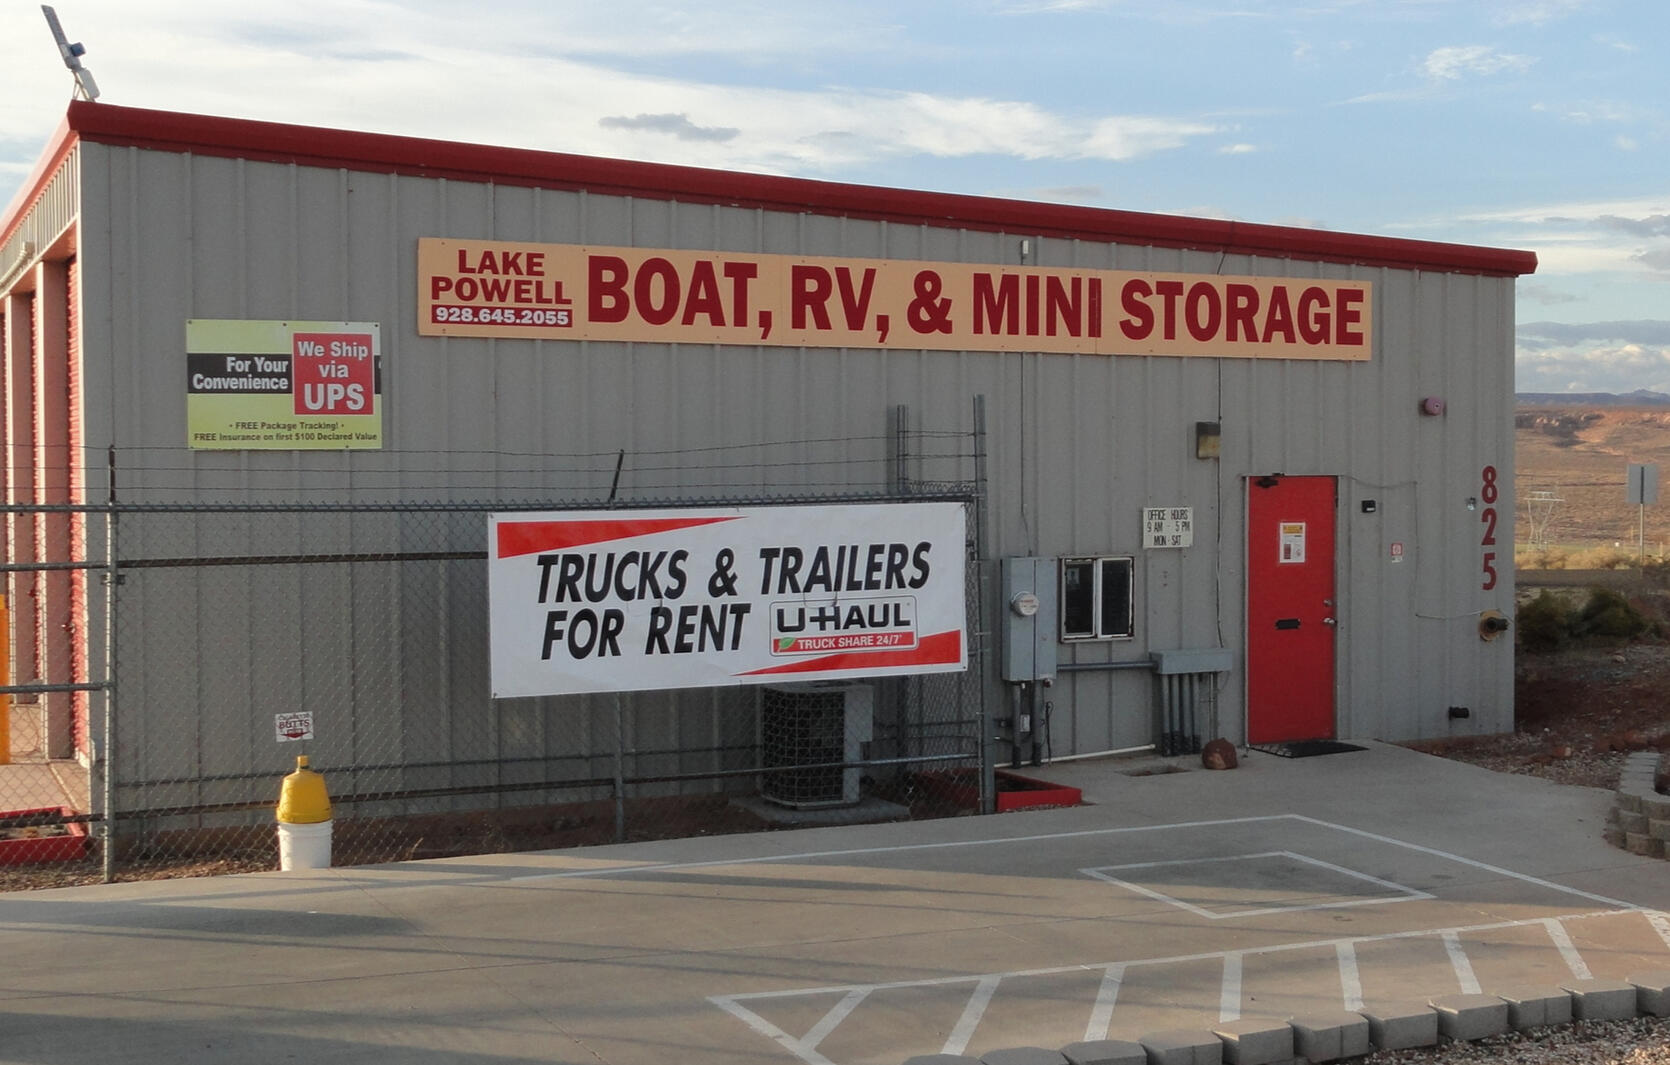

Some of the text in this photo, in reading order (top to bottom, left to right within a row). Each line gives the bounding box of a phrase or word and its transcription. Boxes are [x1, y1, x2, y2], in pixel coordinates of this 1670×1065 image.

[458, 249, 545, 276] LAKE
[431, 276, 572, 305] POWELL
[587, 256, 1364, 346] BOAT, RV, & MINI STORAGE
[436, 307, 569, 325] 928.645.2055
[298, 341, 369, 360] We Ship
[226, 357, 288, 373] For Your
[318, 360, 349, 378] via
[192, 374, 288, 390] Convenience
[304, 383, 365, 411] UPS
[236, 422, 339, 431] FREE Package Tracking!
[194, 433, 217, 441] FREE
[219, 433, 261, 441] Insurance
[276, 433, 293, 441] first
[295, 432, 315, 441] $100
[317, 432, 353, 441] Declared
[355, 432, 377, 441] Value
[1148, 509, 1189, 520] OFFICE HOURS
[1147, 521, 1152, 533] 9
[1154, 521, 1163, 533] AM
[1175, 521, 1180, 532] 5
[1181, 521, 1191, 532] PM
[1153, 535, 1182, 546] MON SAT
[537, 541, 933, 604] TRUCKS & TRAILERS
[541, 603, 751, 661] FOR RENT
[798, 638, 836, 650] TRUCK
[838, 636, 875, 648] SHARE
[279, 720, 310, 729] BUTTS
